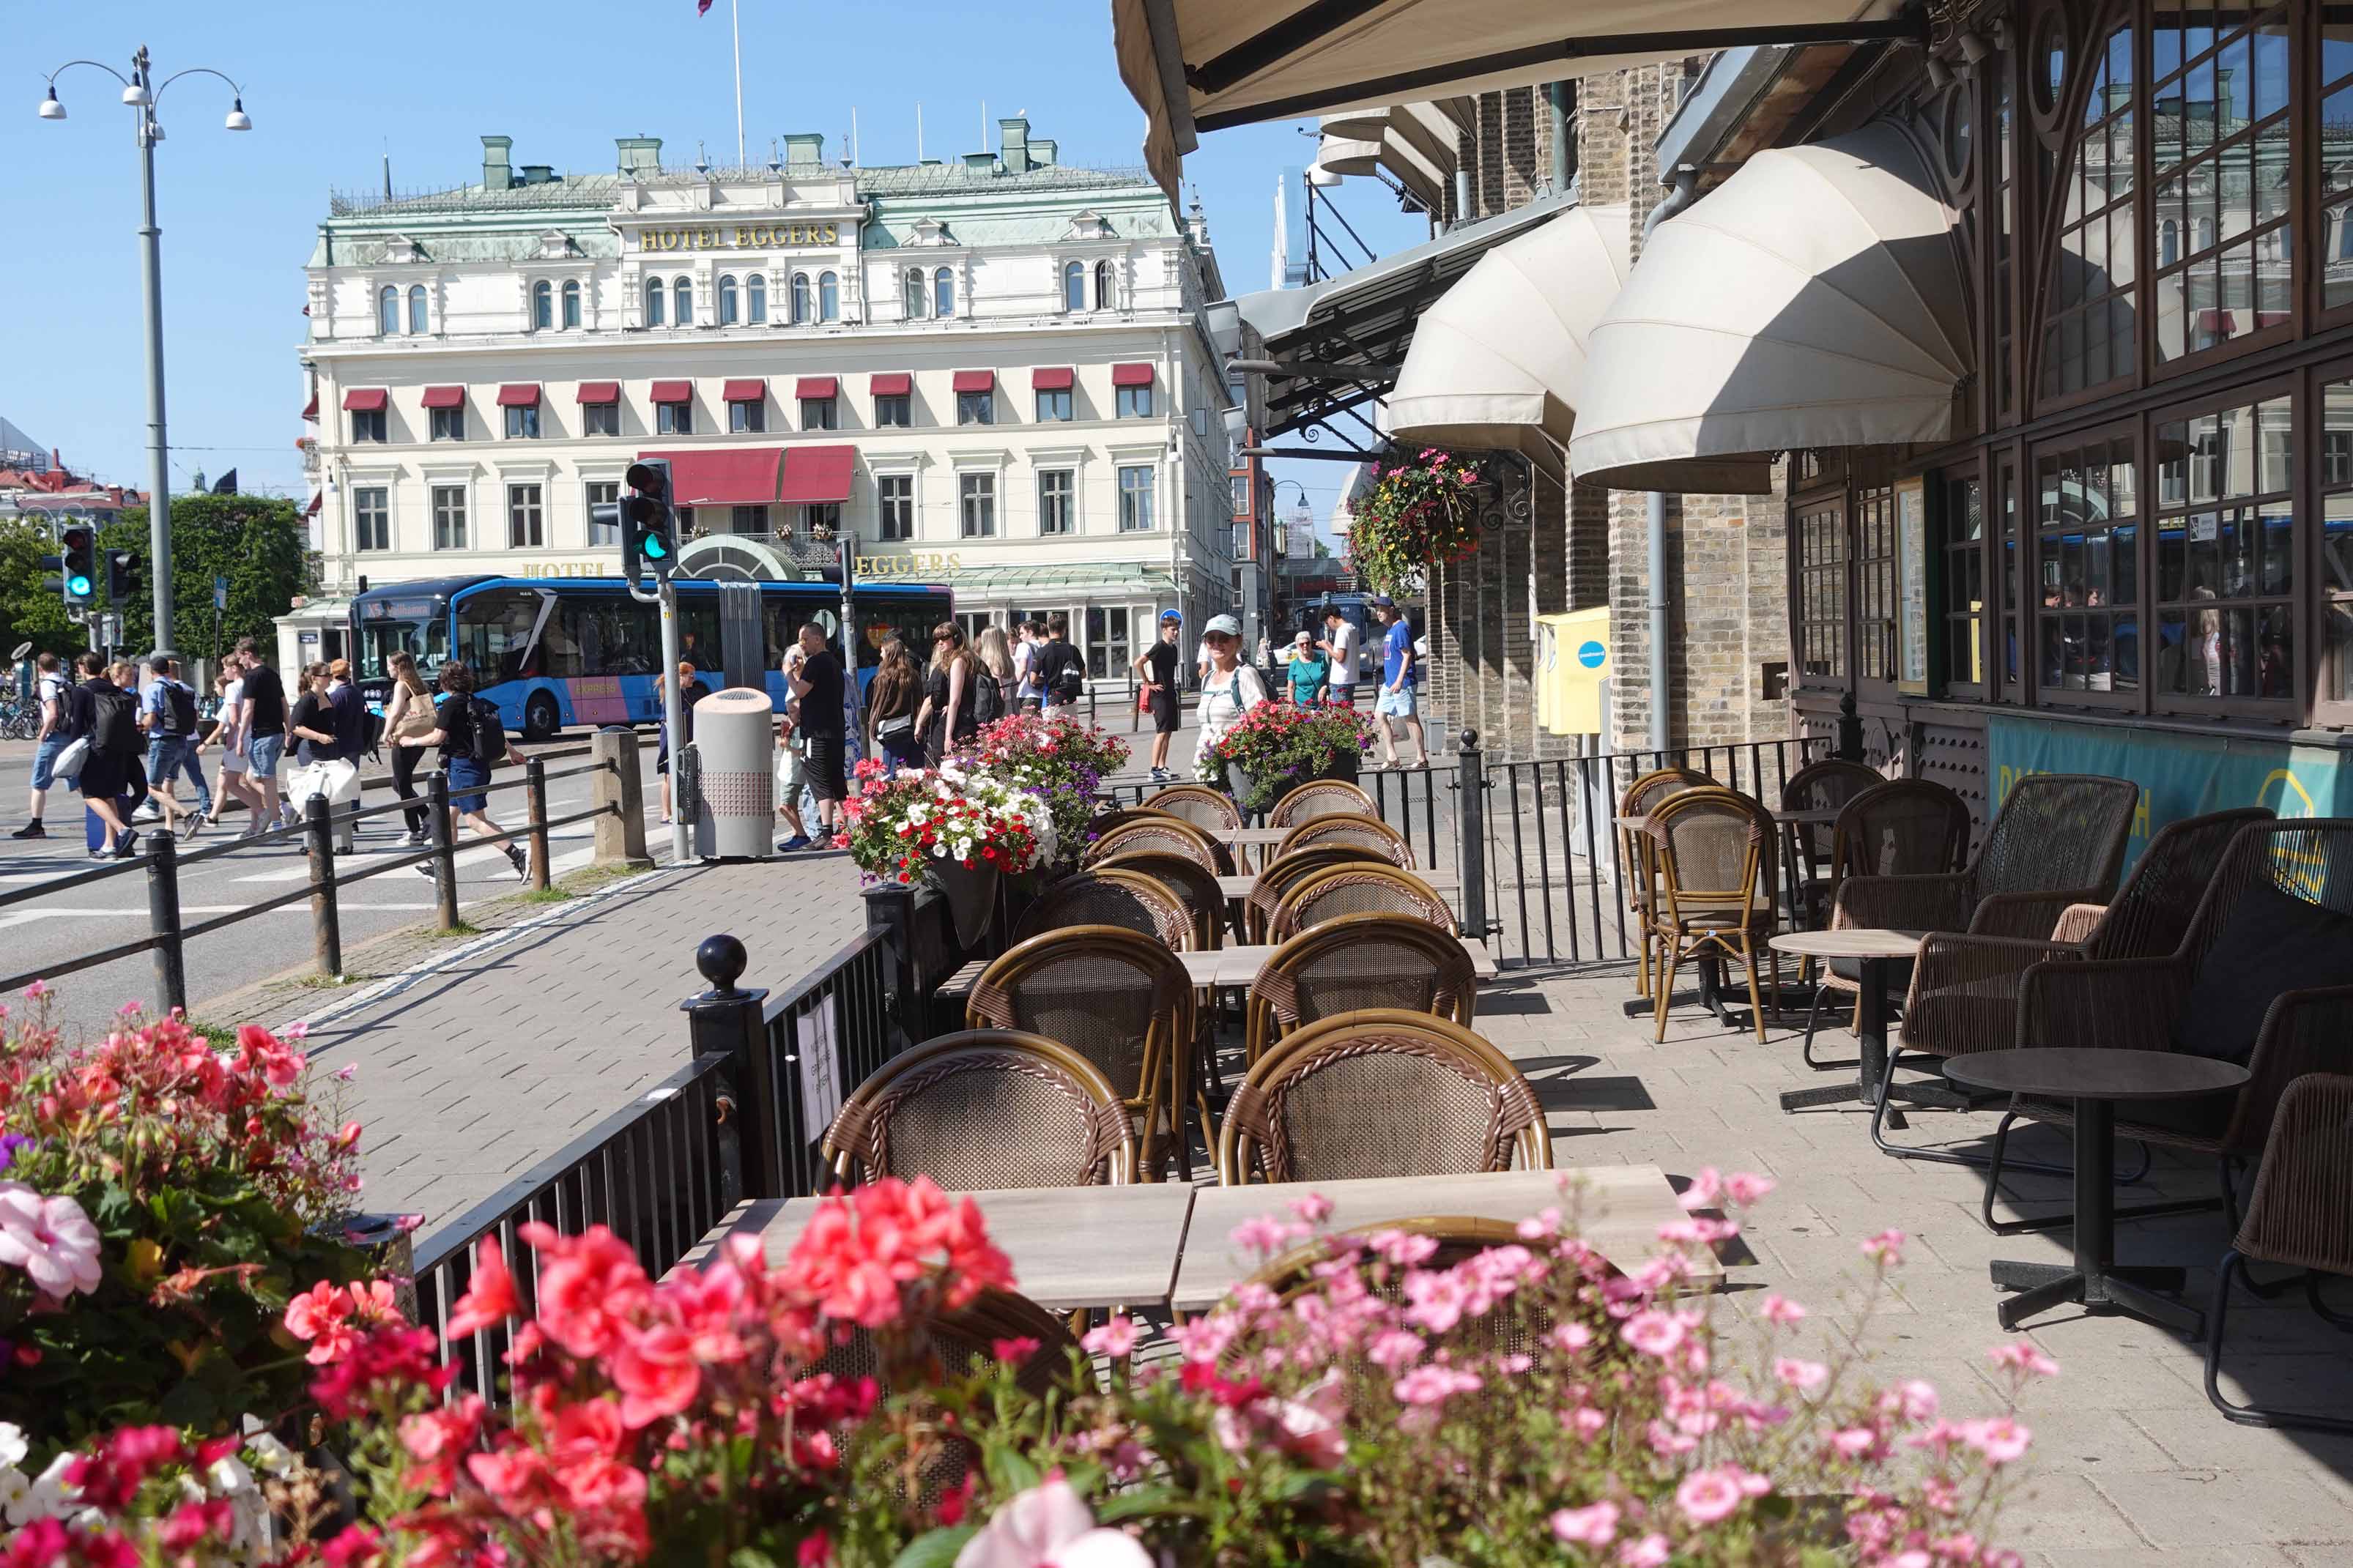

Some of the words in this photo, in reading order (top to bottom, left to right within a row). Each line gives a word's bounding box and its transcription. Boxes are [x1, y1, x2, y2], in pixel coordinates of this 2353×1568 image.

[641, 228, 727, 250] HOTEL
[735, 224, 837, 247] EGGERS
[855, 552, 961, 576] EGGERS
[574, 685, 616, 694] EXPRESS
